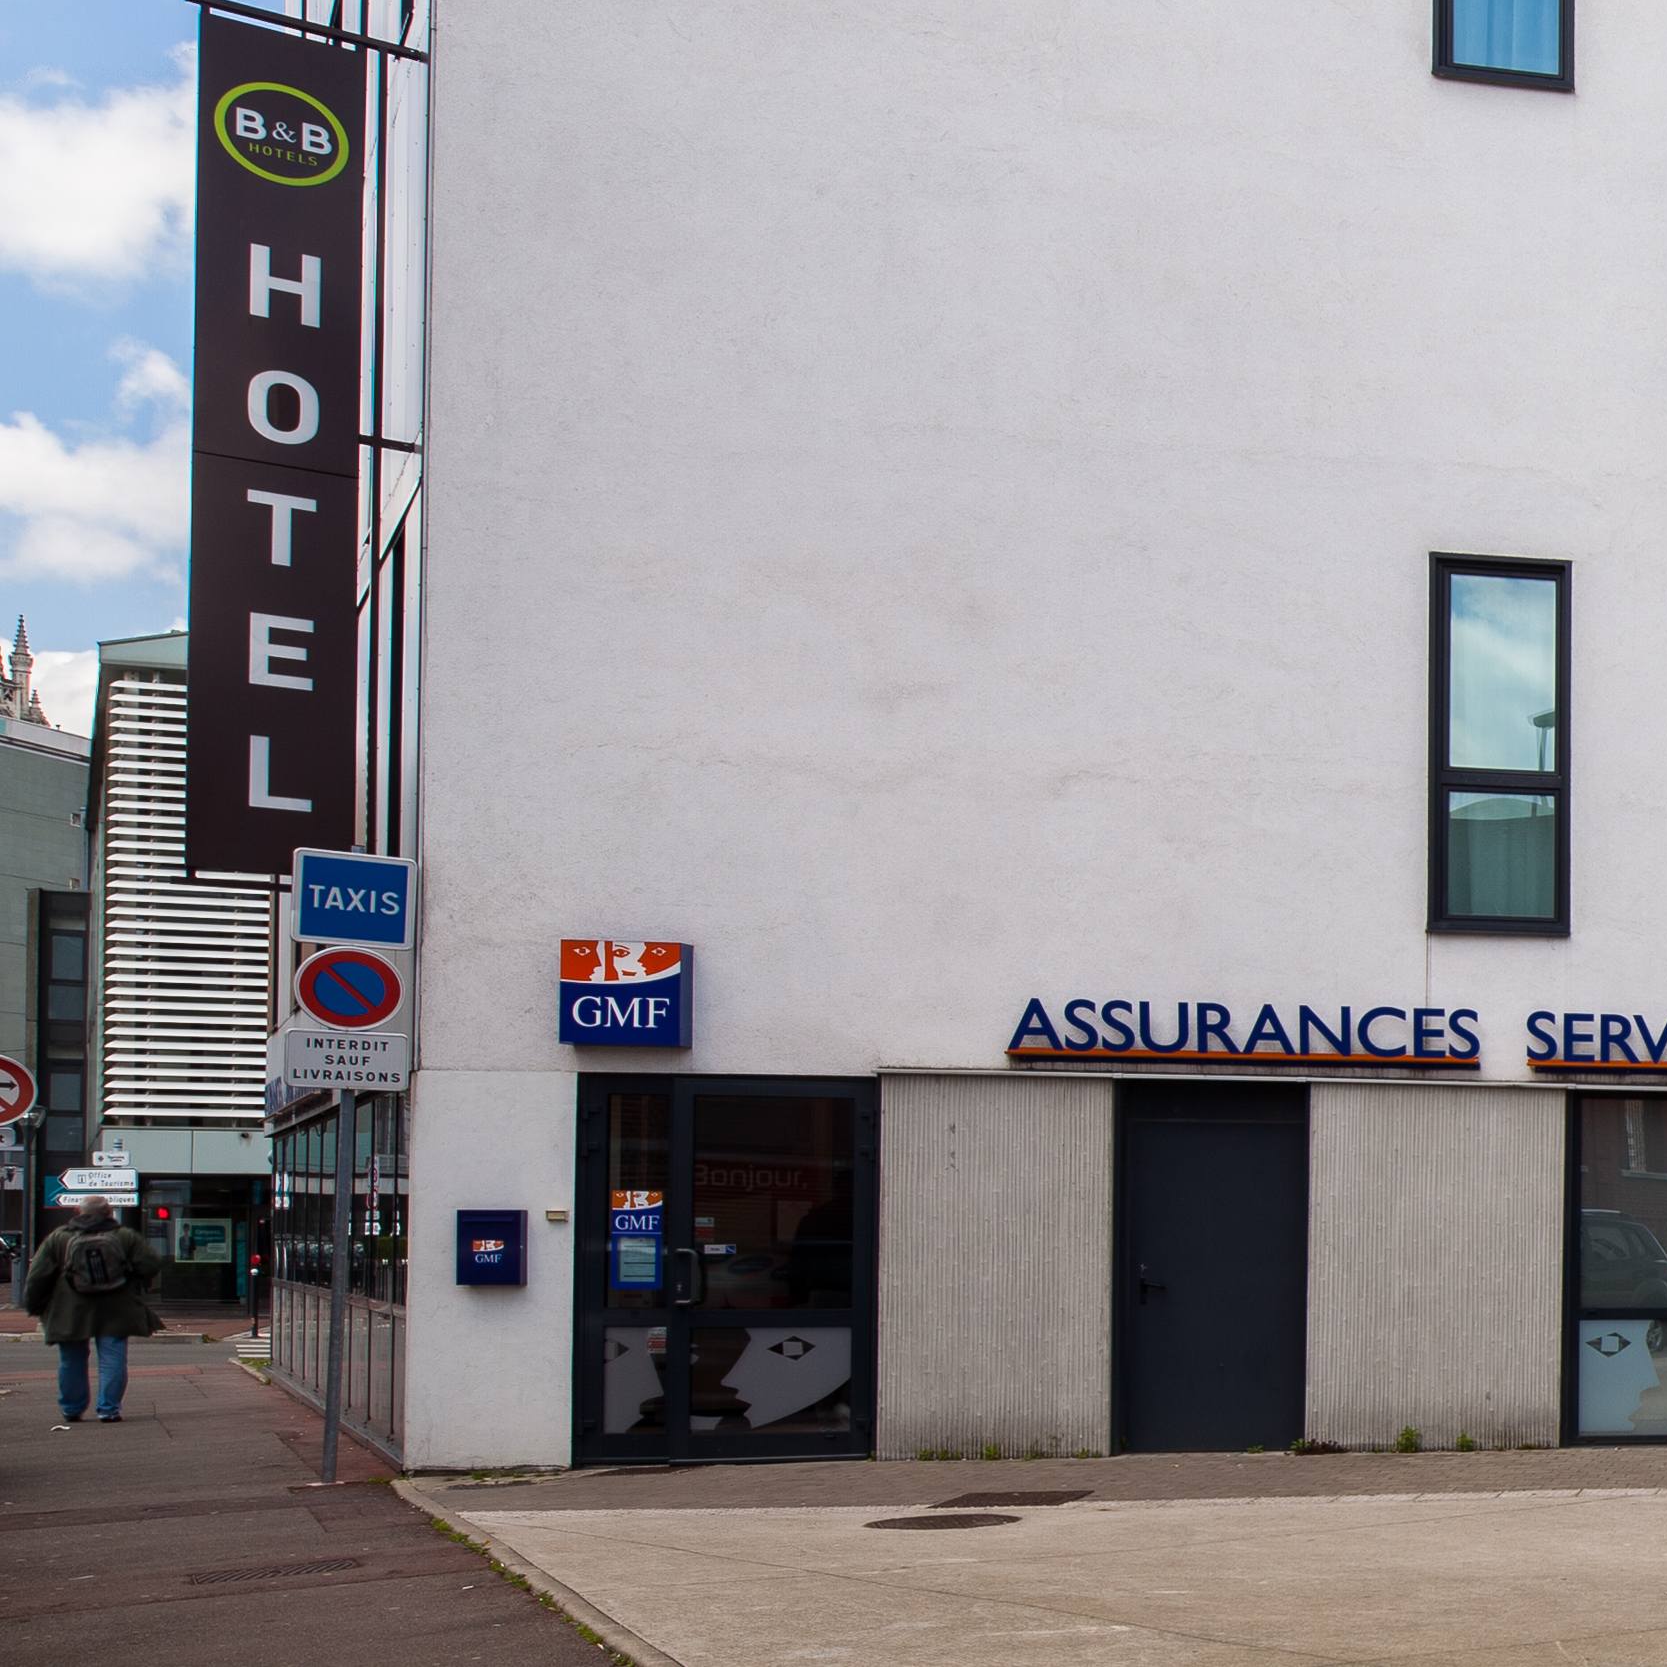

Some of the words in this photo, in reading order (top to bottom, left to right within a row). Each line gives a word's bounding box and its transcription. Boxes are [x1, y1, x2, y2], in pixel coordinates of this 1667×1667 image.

[236, 106, 333, 155] B&B
[249, 142, 319, 167] HOTELS
[247, 242, 321, 813] HOTEL
[308, 884, 400, 915] TAXIS
[572, 995, 671, 1029] GMF
[1008, 998, 1481, 1060] ASSURANCES
[306, 1037, 390, 1052] INTERDIT
[324, 1054, 371, 1066] SAUF
[292, 1068, 401, 1084] LIVRAISONS
[88, 1171, 112, 1179] Office
[615, 1214, 660, 1231] GMF
[475, 1253, 503, 1263] GMF
